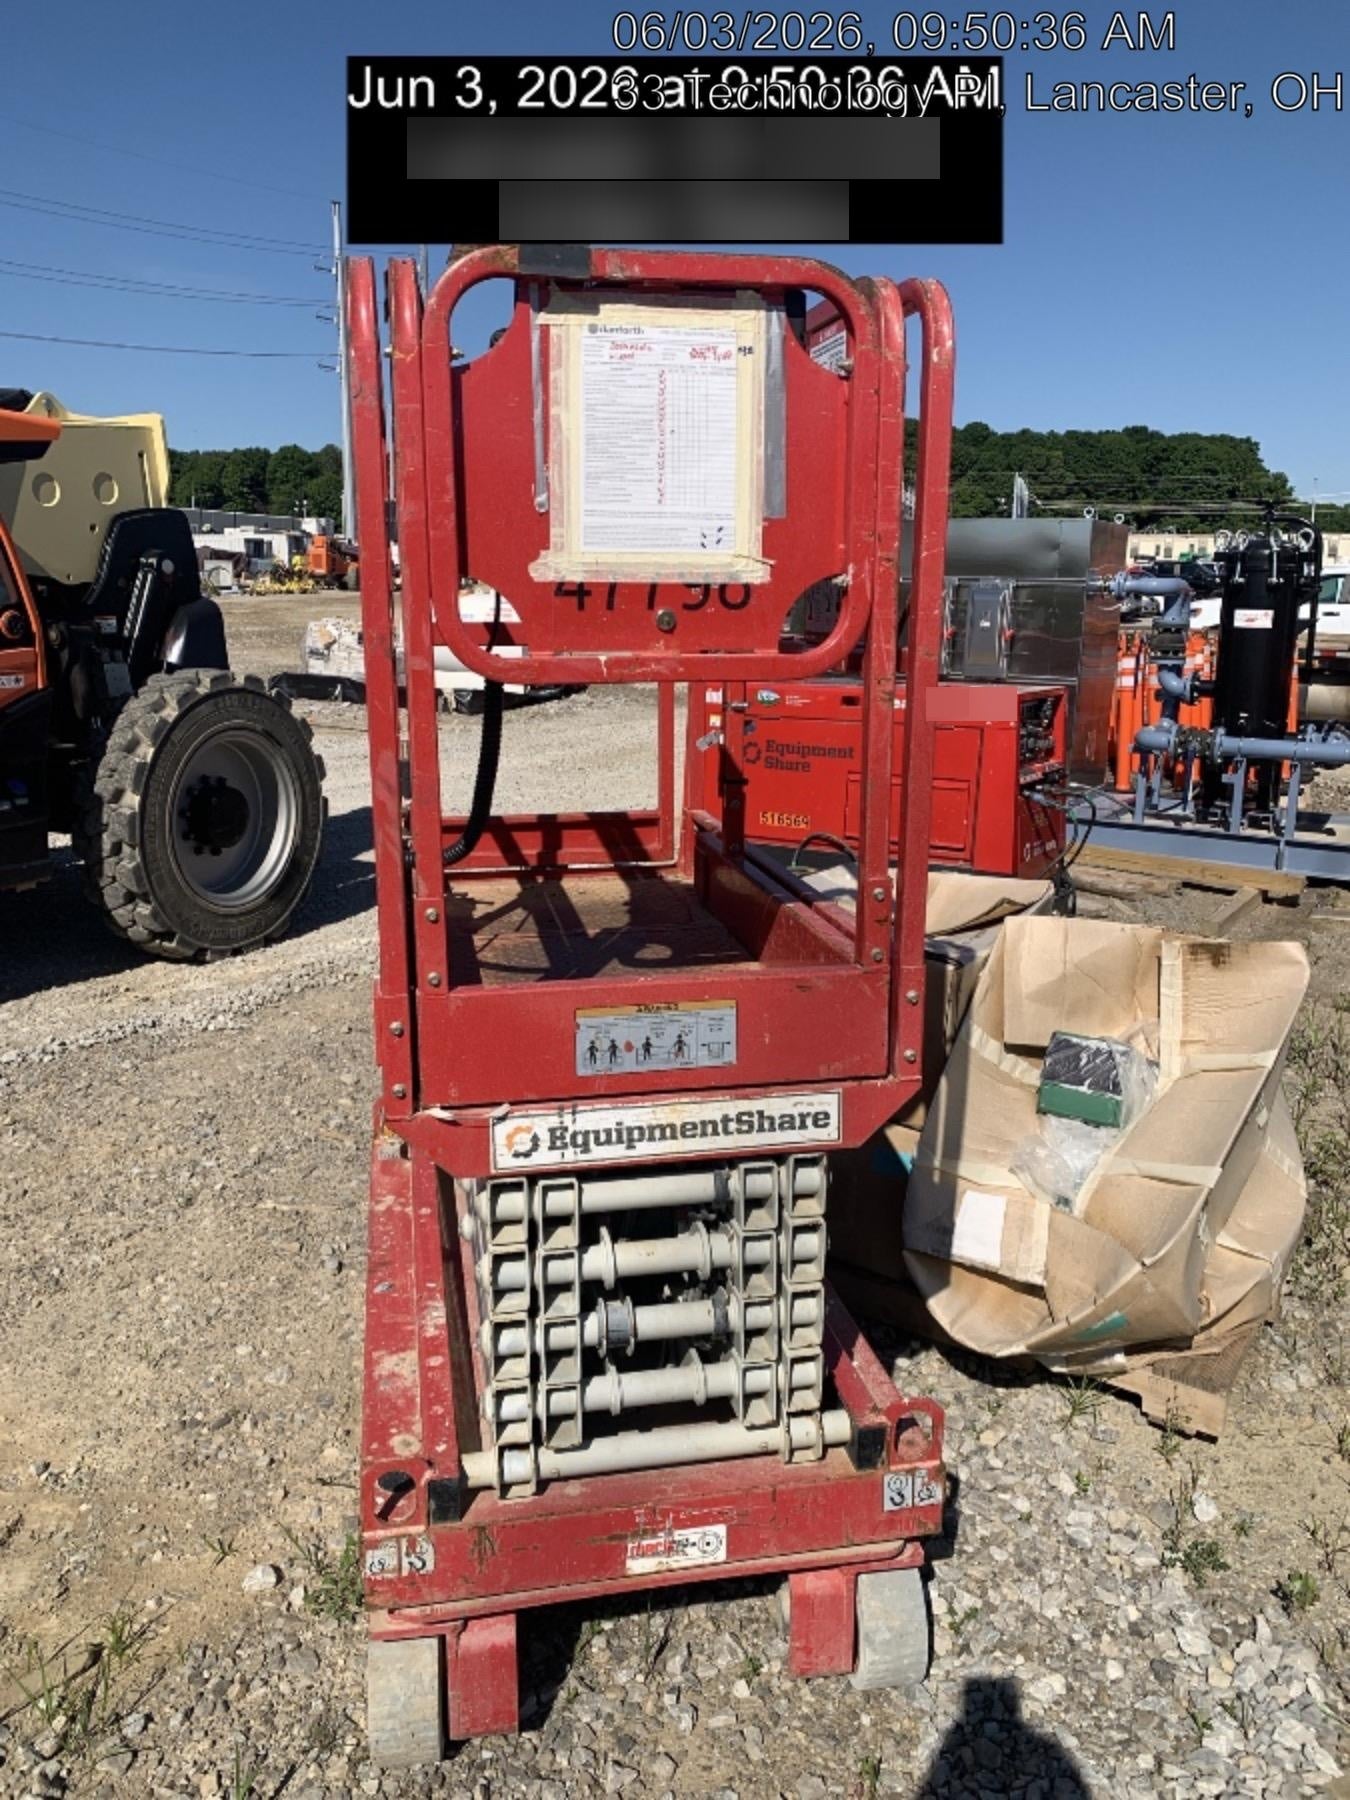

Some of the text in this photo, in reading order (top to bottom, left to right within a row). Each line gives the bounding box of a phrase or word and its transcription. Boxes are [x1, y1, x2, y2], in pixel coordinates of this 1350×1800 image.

[765, 739, 855, 760] Equipment
[764, 755, 811, 773] Share
[548, 1110, 831, 1152] EquipmentShare
